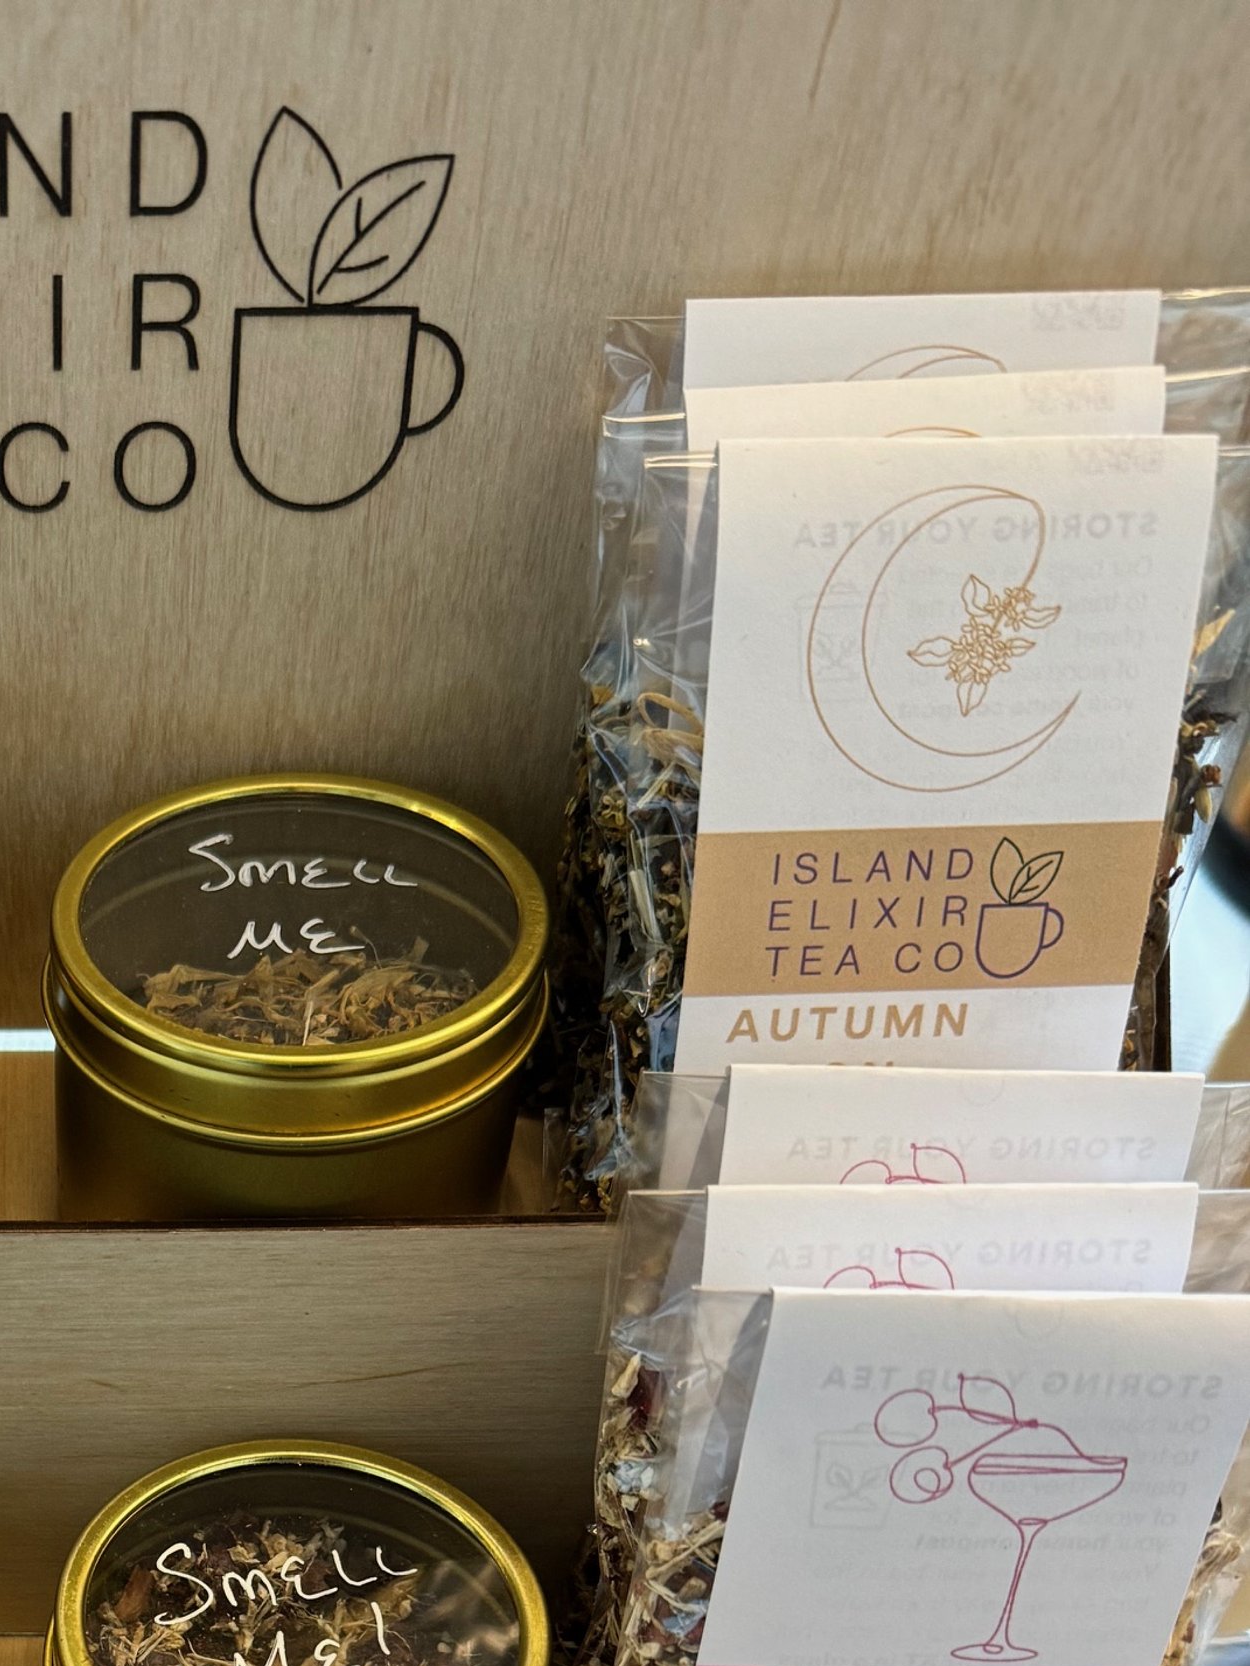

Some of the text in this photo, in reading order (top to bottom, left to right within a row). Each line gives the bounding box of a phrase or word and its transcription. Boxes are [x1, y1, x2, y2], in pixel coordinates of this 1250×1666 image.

[773, 848, 976, 886] ISLAND
[768, 896, 968, 933] ELIXIR
[765, 942, 965, 978] TEA CO
[725, 1002, 969, 1043] AUTUMN
